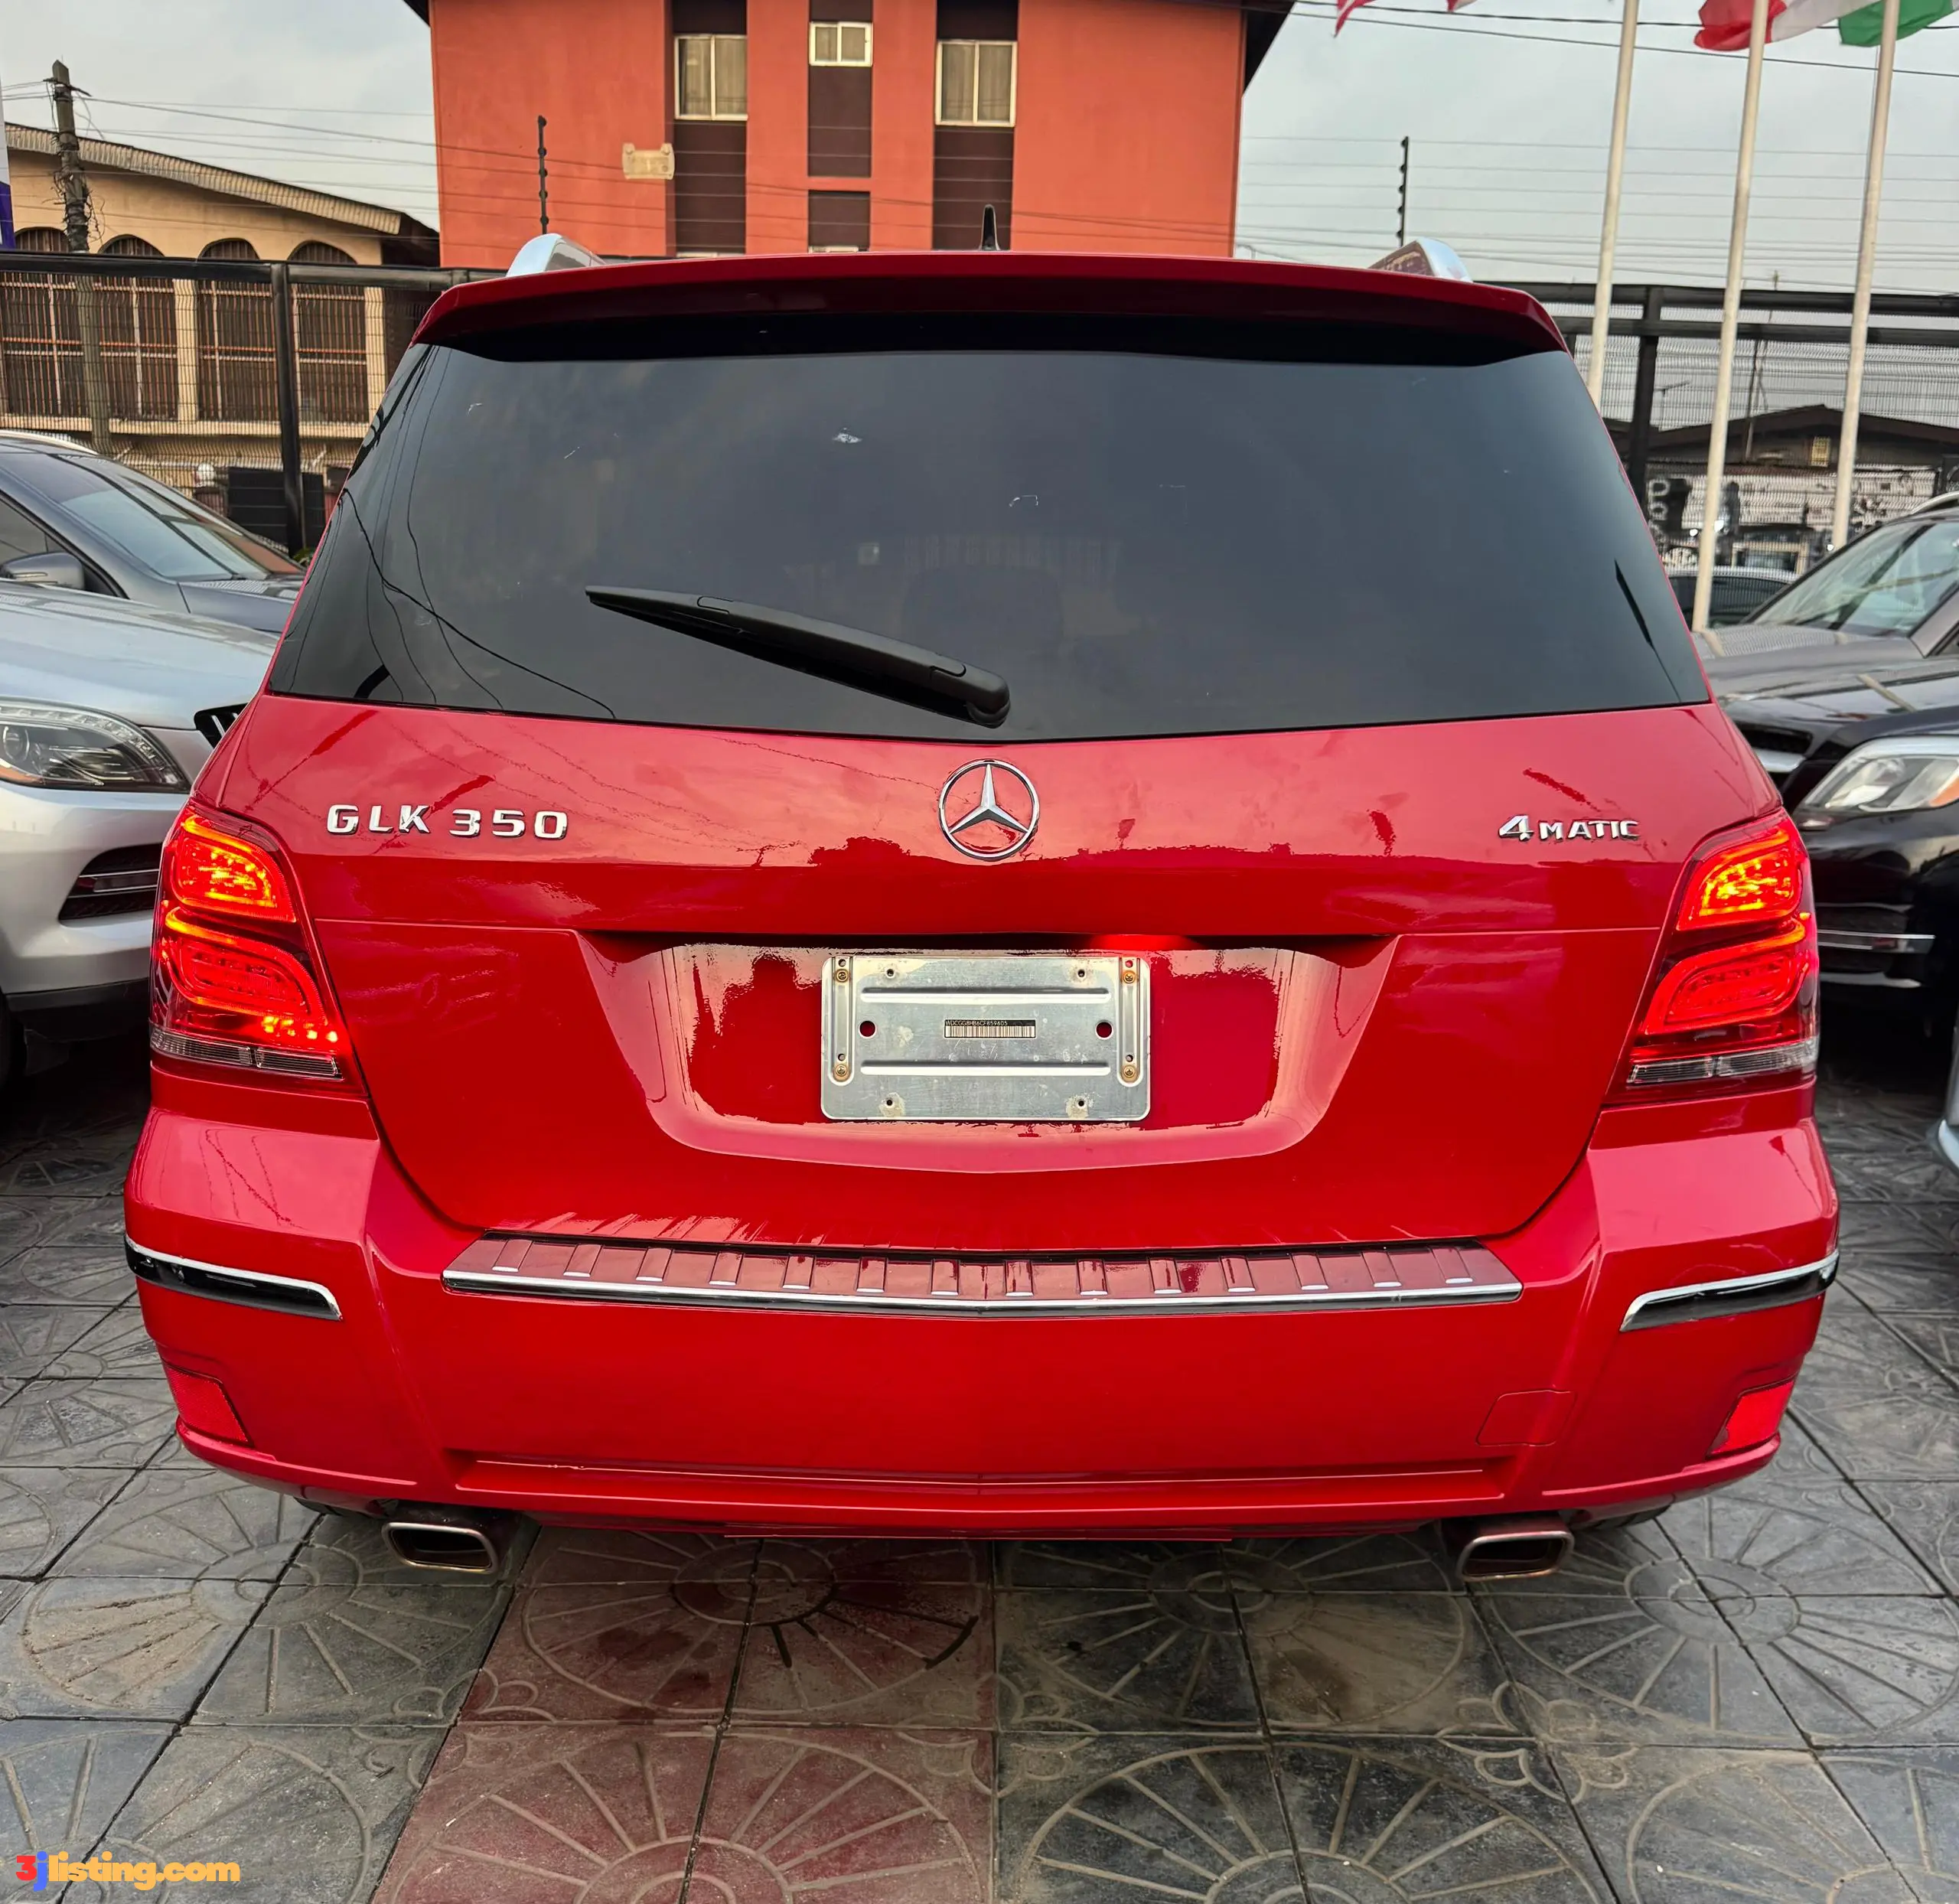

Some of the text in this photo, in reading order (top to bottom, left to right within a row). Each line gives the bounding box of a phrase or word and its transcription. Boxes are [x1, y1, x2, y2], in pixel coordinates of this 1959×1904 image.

[327, 804, 569, 840] GLK 350
[1498, 814, 1639, 841] 4MATIC
